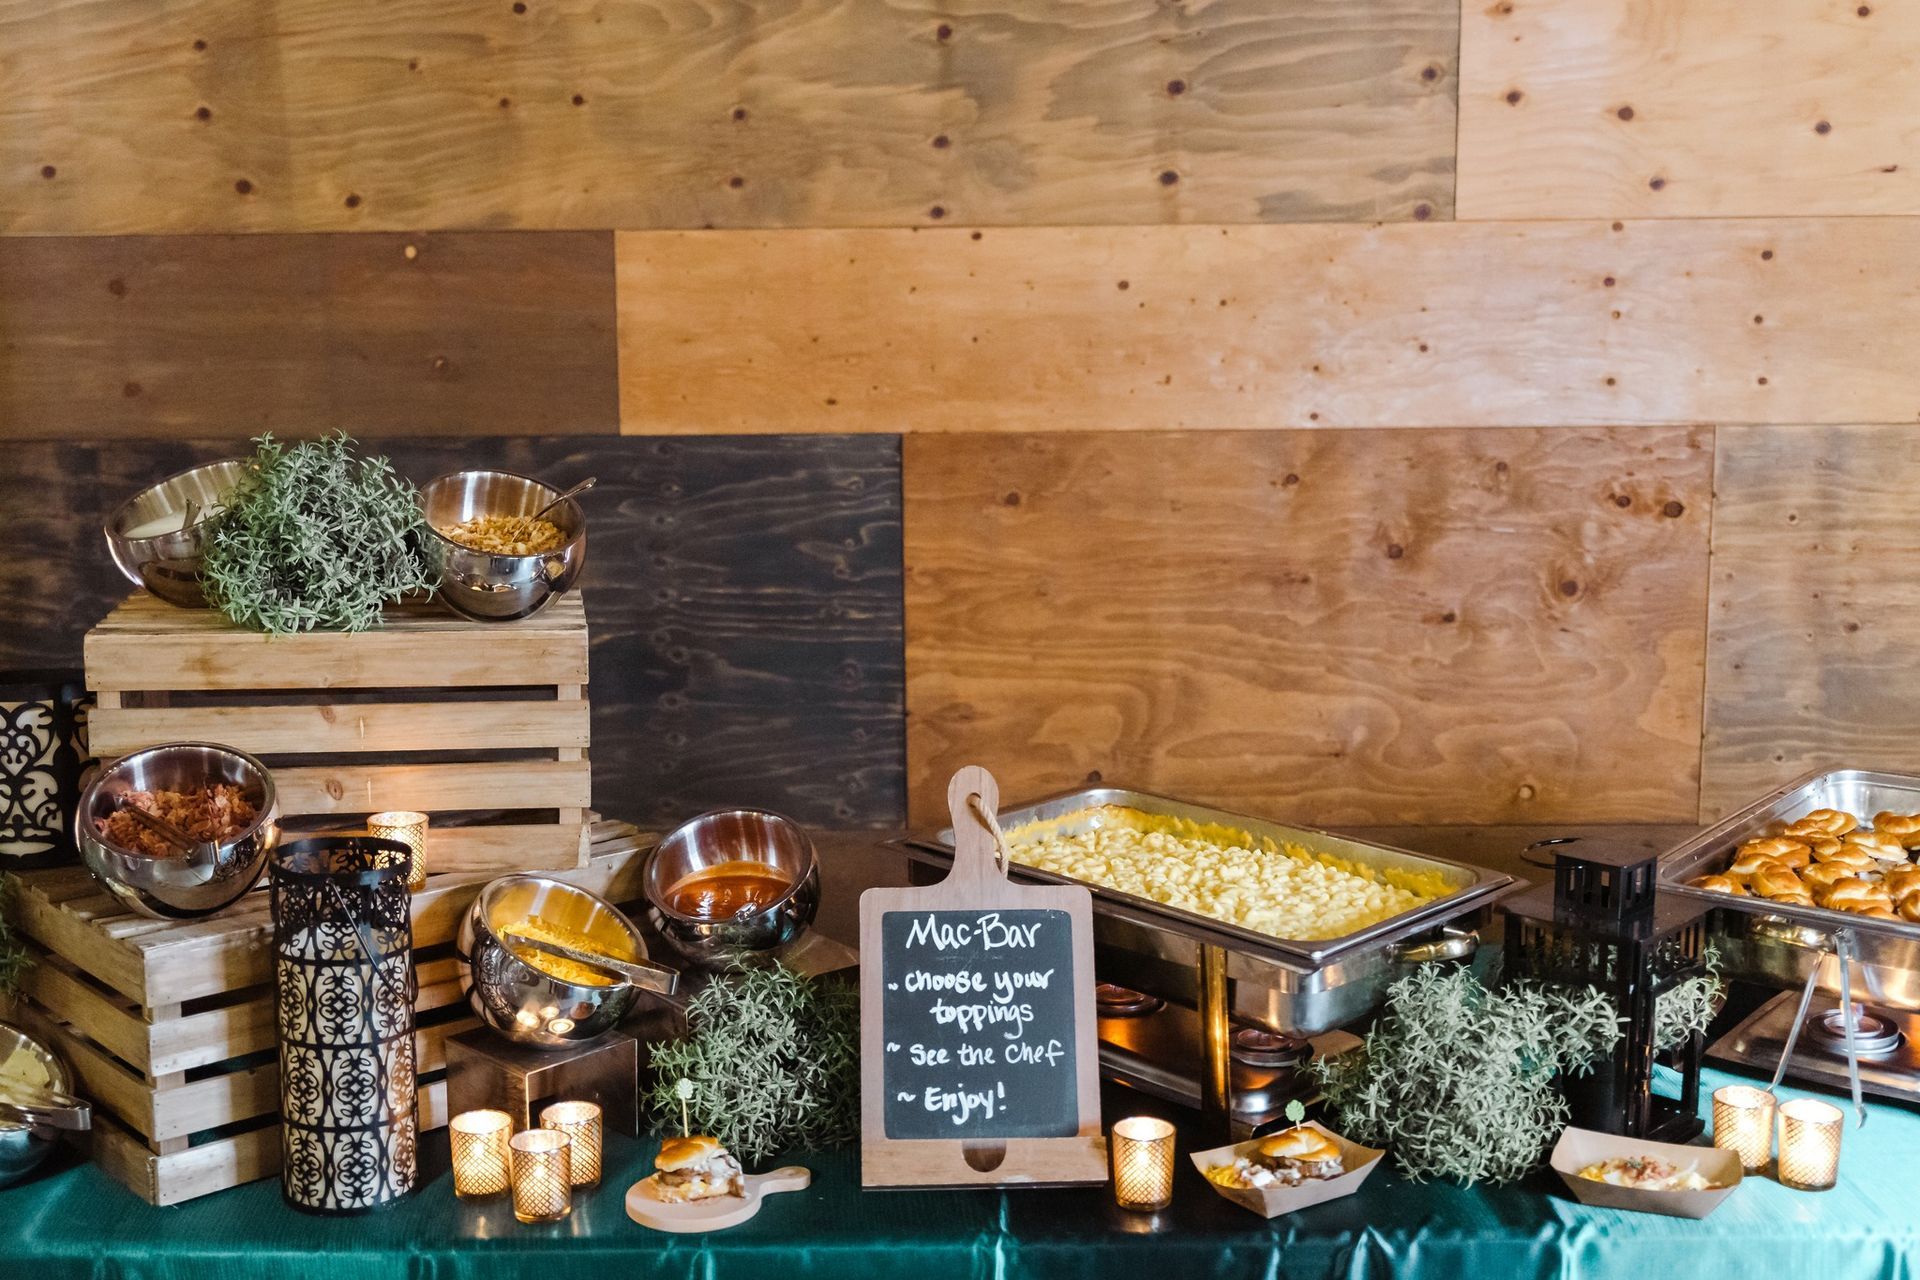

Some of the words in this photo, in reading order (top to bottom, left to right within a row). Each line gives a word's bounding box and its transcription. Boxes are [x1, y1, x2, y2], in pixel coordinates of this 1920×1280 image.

[906, 912, 1042, 951] Mac-Bar
[905, 969, 987, 994] choose
[992, 968, 1055, 1004] your
[929, 998, 1035, 1039] toppings
[957, 1043, 996, 1067] the
[924, 1081, 1007, 1125] Enjoy!
